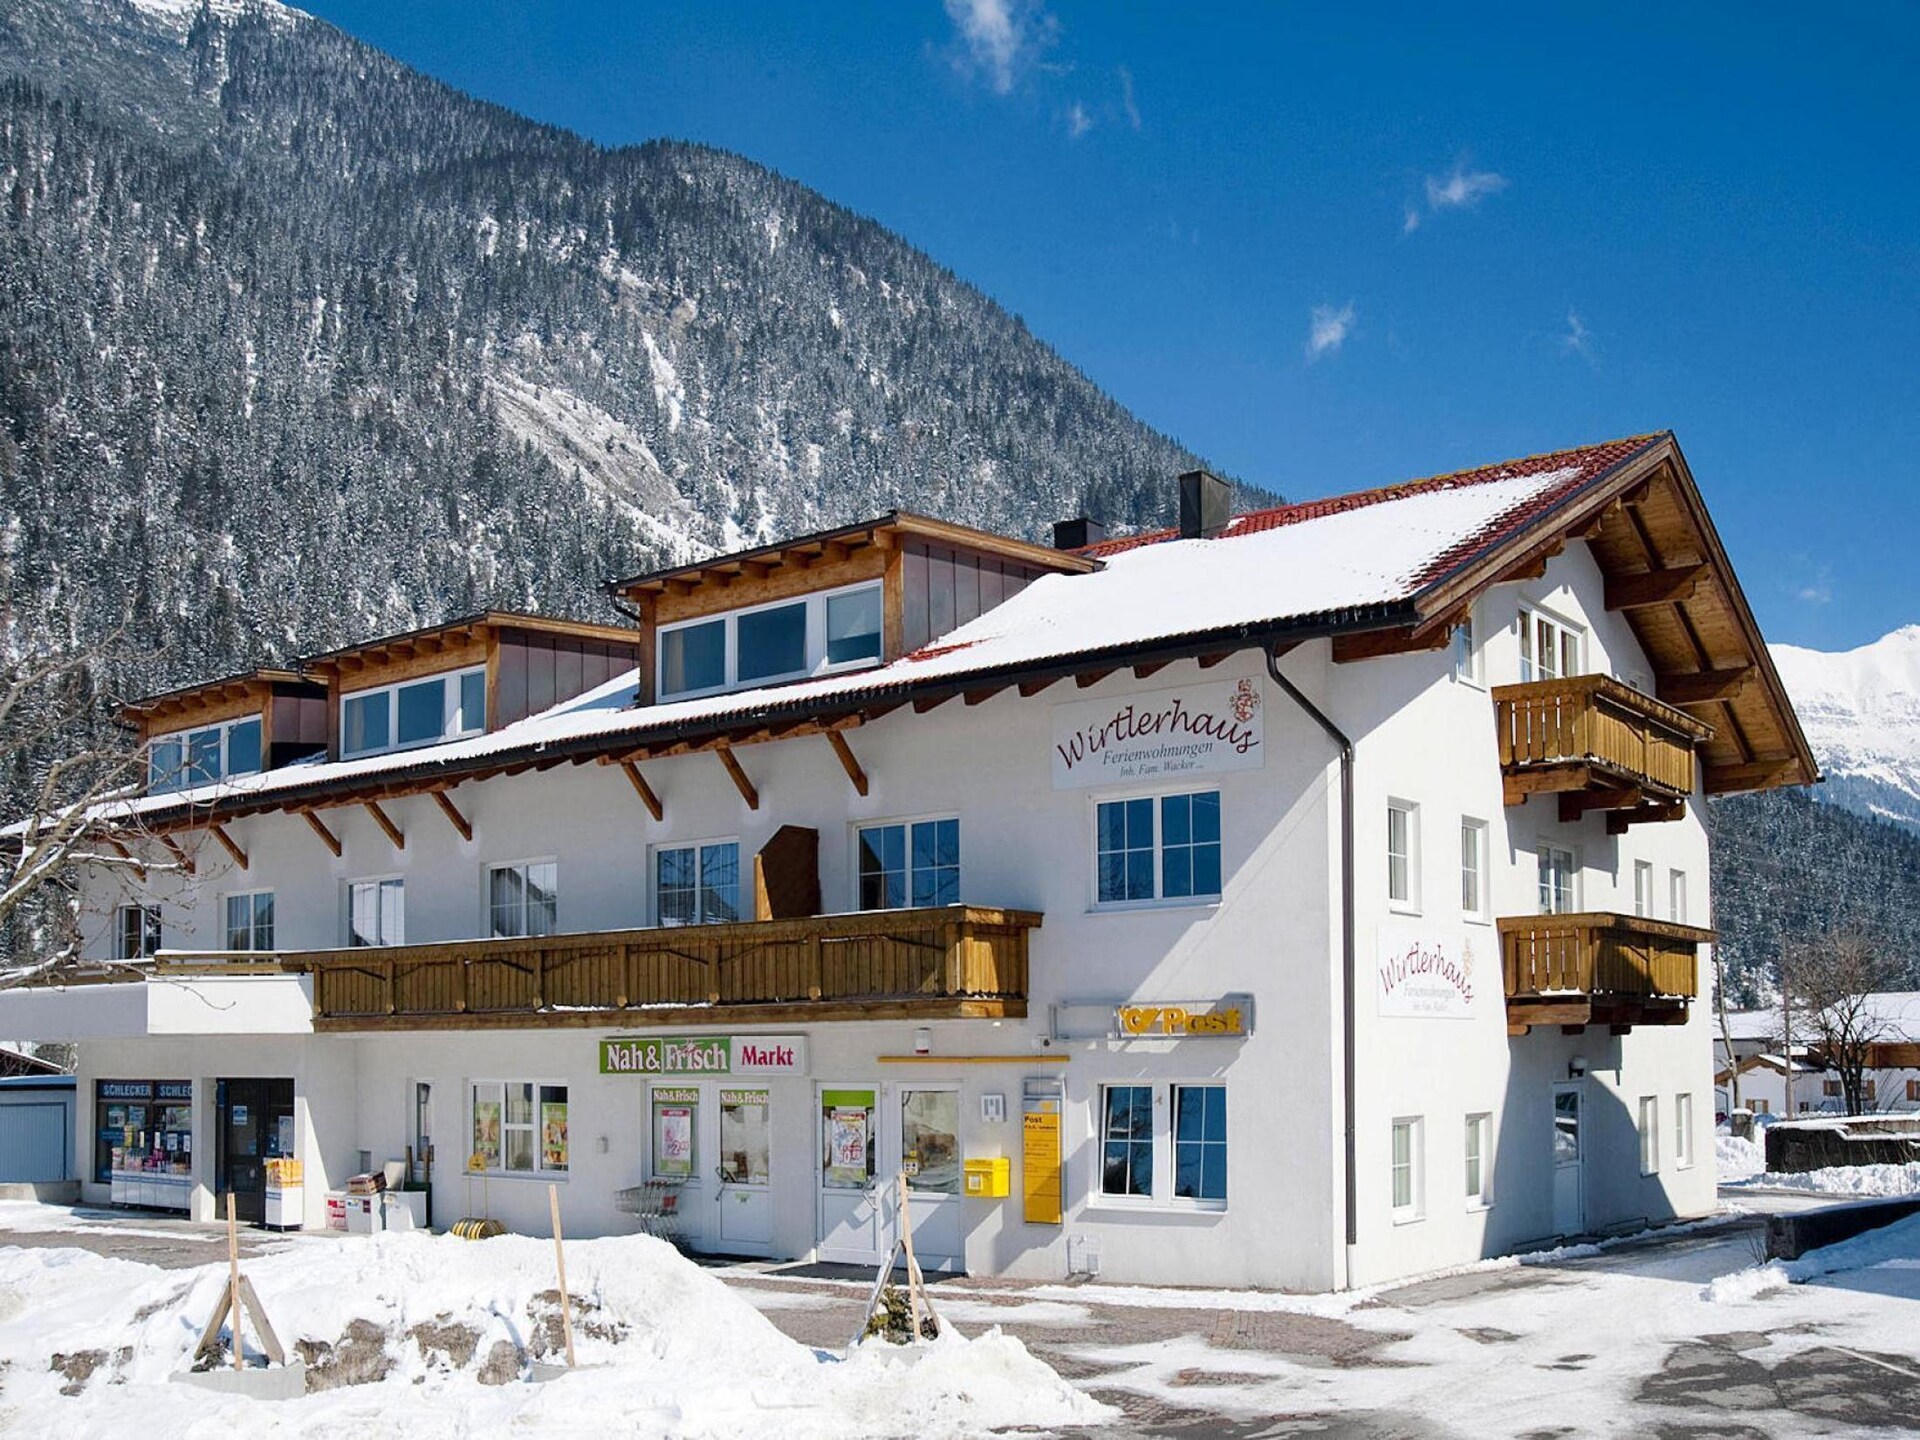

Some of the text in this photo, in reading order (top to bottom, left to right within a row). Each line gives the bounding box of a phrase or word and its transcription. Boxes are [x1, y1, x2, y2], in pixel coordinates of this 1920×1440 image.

[1057, 700, 1260, 769] Wirtlerhaus
[1102, 742, 1213, 766] Ferienwohnungen
[1381, 942, 1474, 1004] Wirtlerhaus
[1162, 1008, 1242, 1034] Post
[742, 1045, 794, 1066] Markt
[103, 1085, 151, 1096] SCHLECKER
